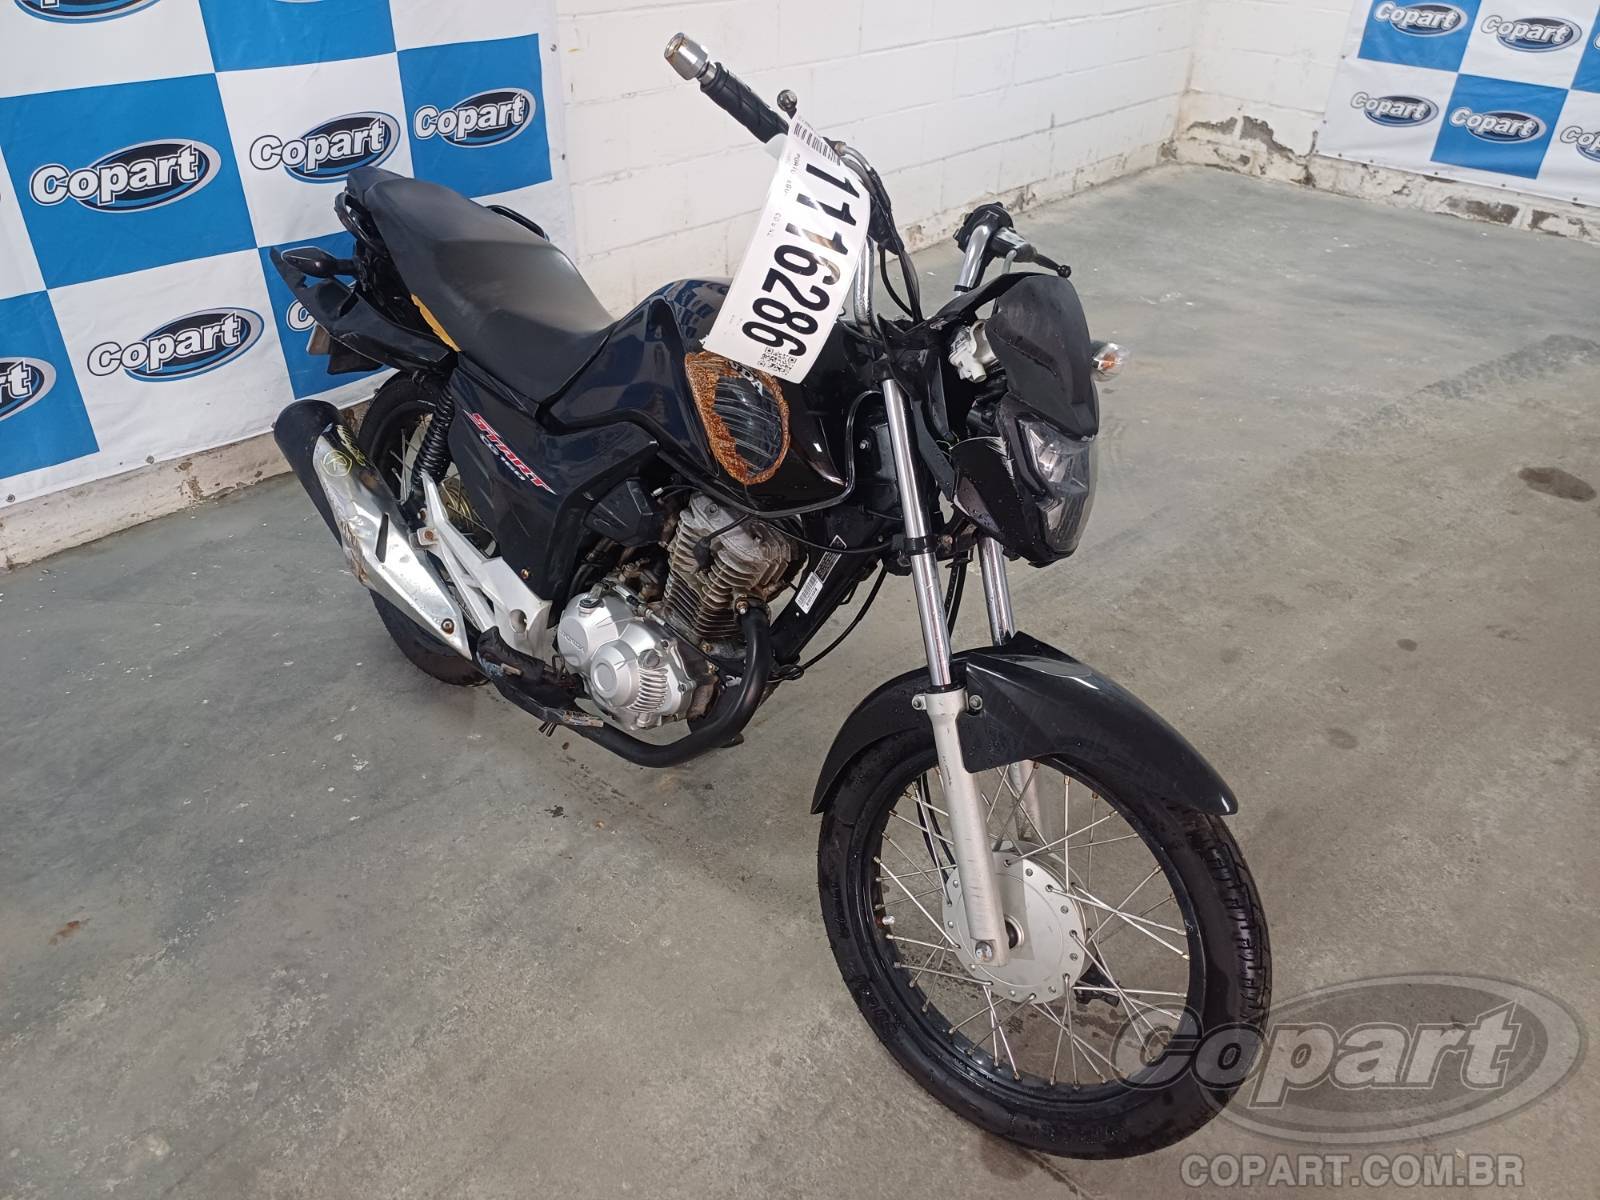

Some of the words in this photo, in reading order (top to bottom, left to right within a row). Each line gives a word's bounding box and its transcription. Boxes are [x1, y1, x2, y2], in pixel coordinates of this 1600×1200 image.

[1374, 2, 1459, 31] Copart
[1481, 15, 1572, 45] Copart
[414, 93, 526, 141] Copart
[1350, 91, 1429, 121] Copart
[1450, 107, 1537, 138] Copart
[250, 117, 385, 173] Copart
[31, 144, 199, 206] Copart
[742, 162, 860, 357] 1116286
[87, 311, 242, 377] Copart
